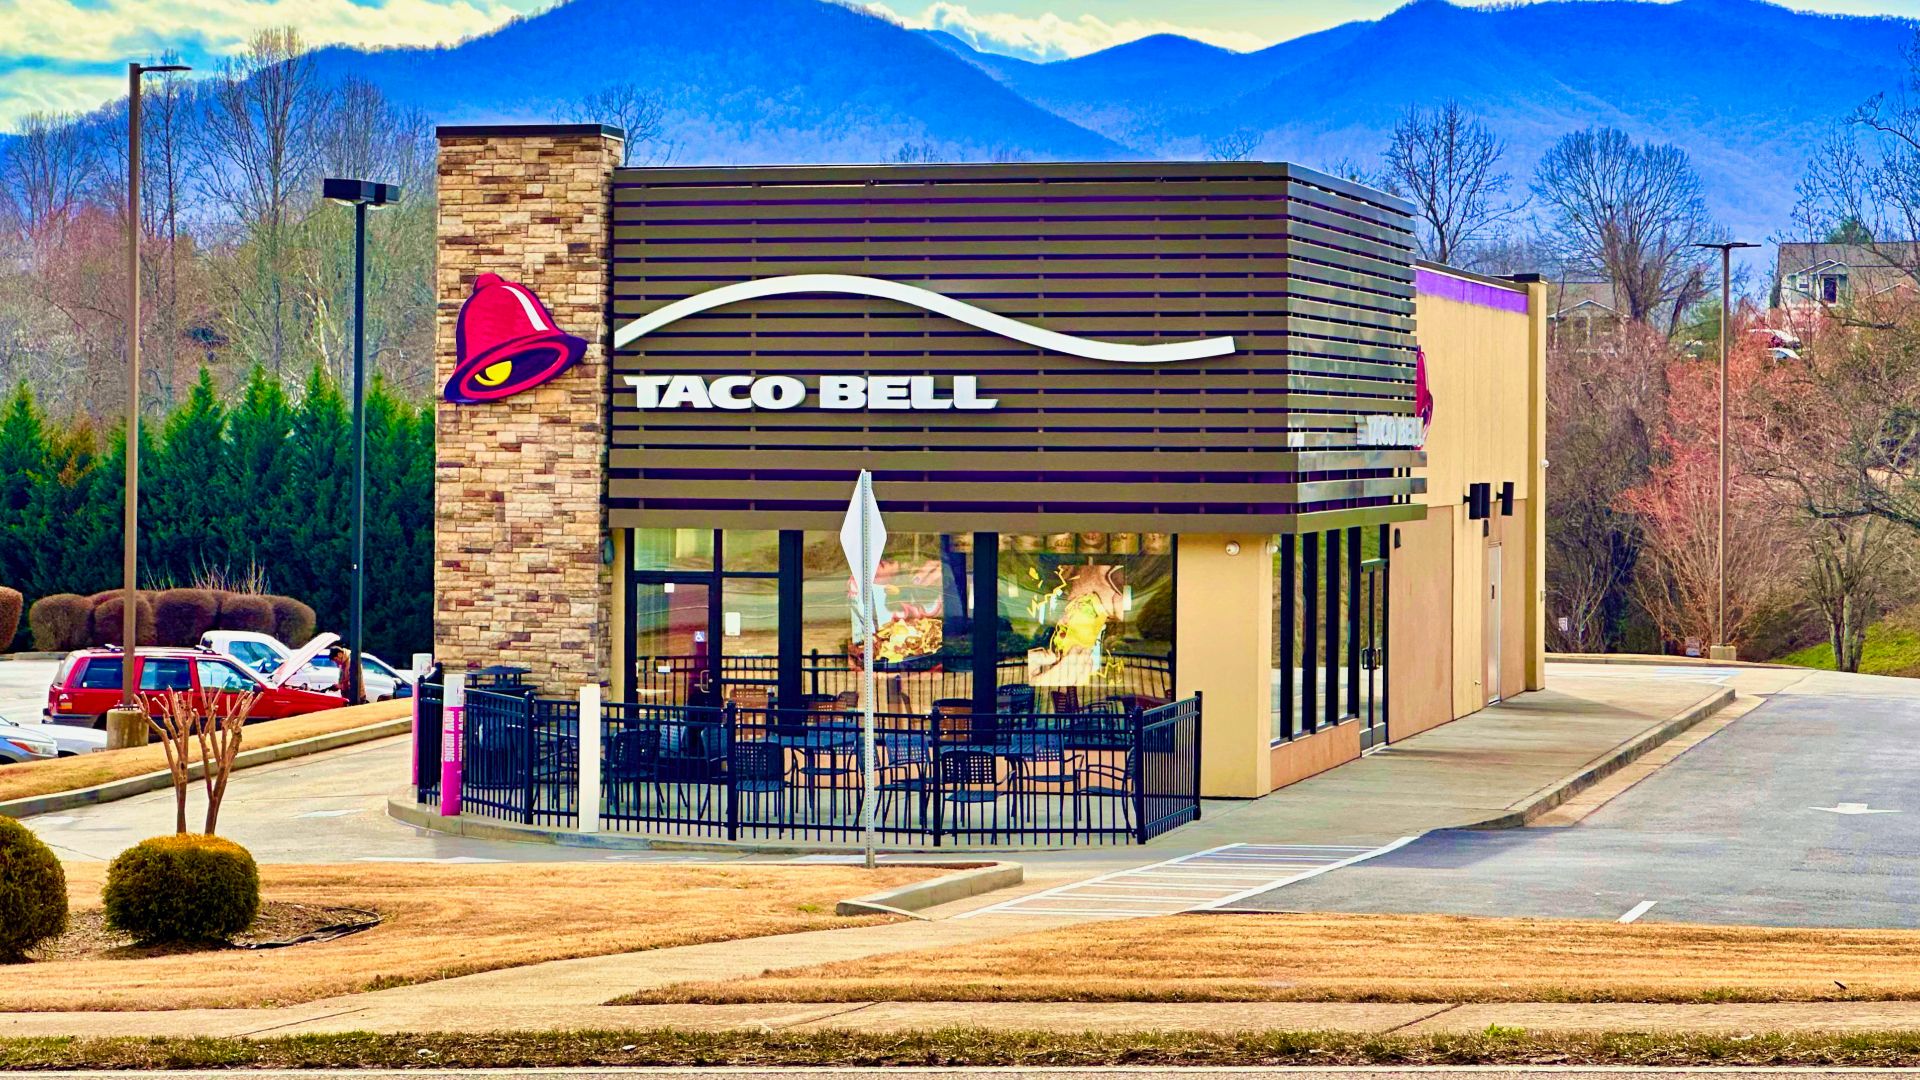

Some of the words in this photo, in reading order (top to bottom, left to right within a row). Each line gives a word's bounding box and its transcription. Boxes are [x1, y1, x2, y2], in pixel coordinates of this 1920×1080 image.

[623, 375, 806, 410] TACO
[819, 375, 999, 410] BELL
[1364, 414, 1397, 446] TACO
[1397, 416, 1424, 447] BELL
[444, 711, 455, 730] NOW
[444, 733, 455, 762] HIRING
